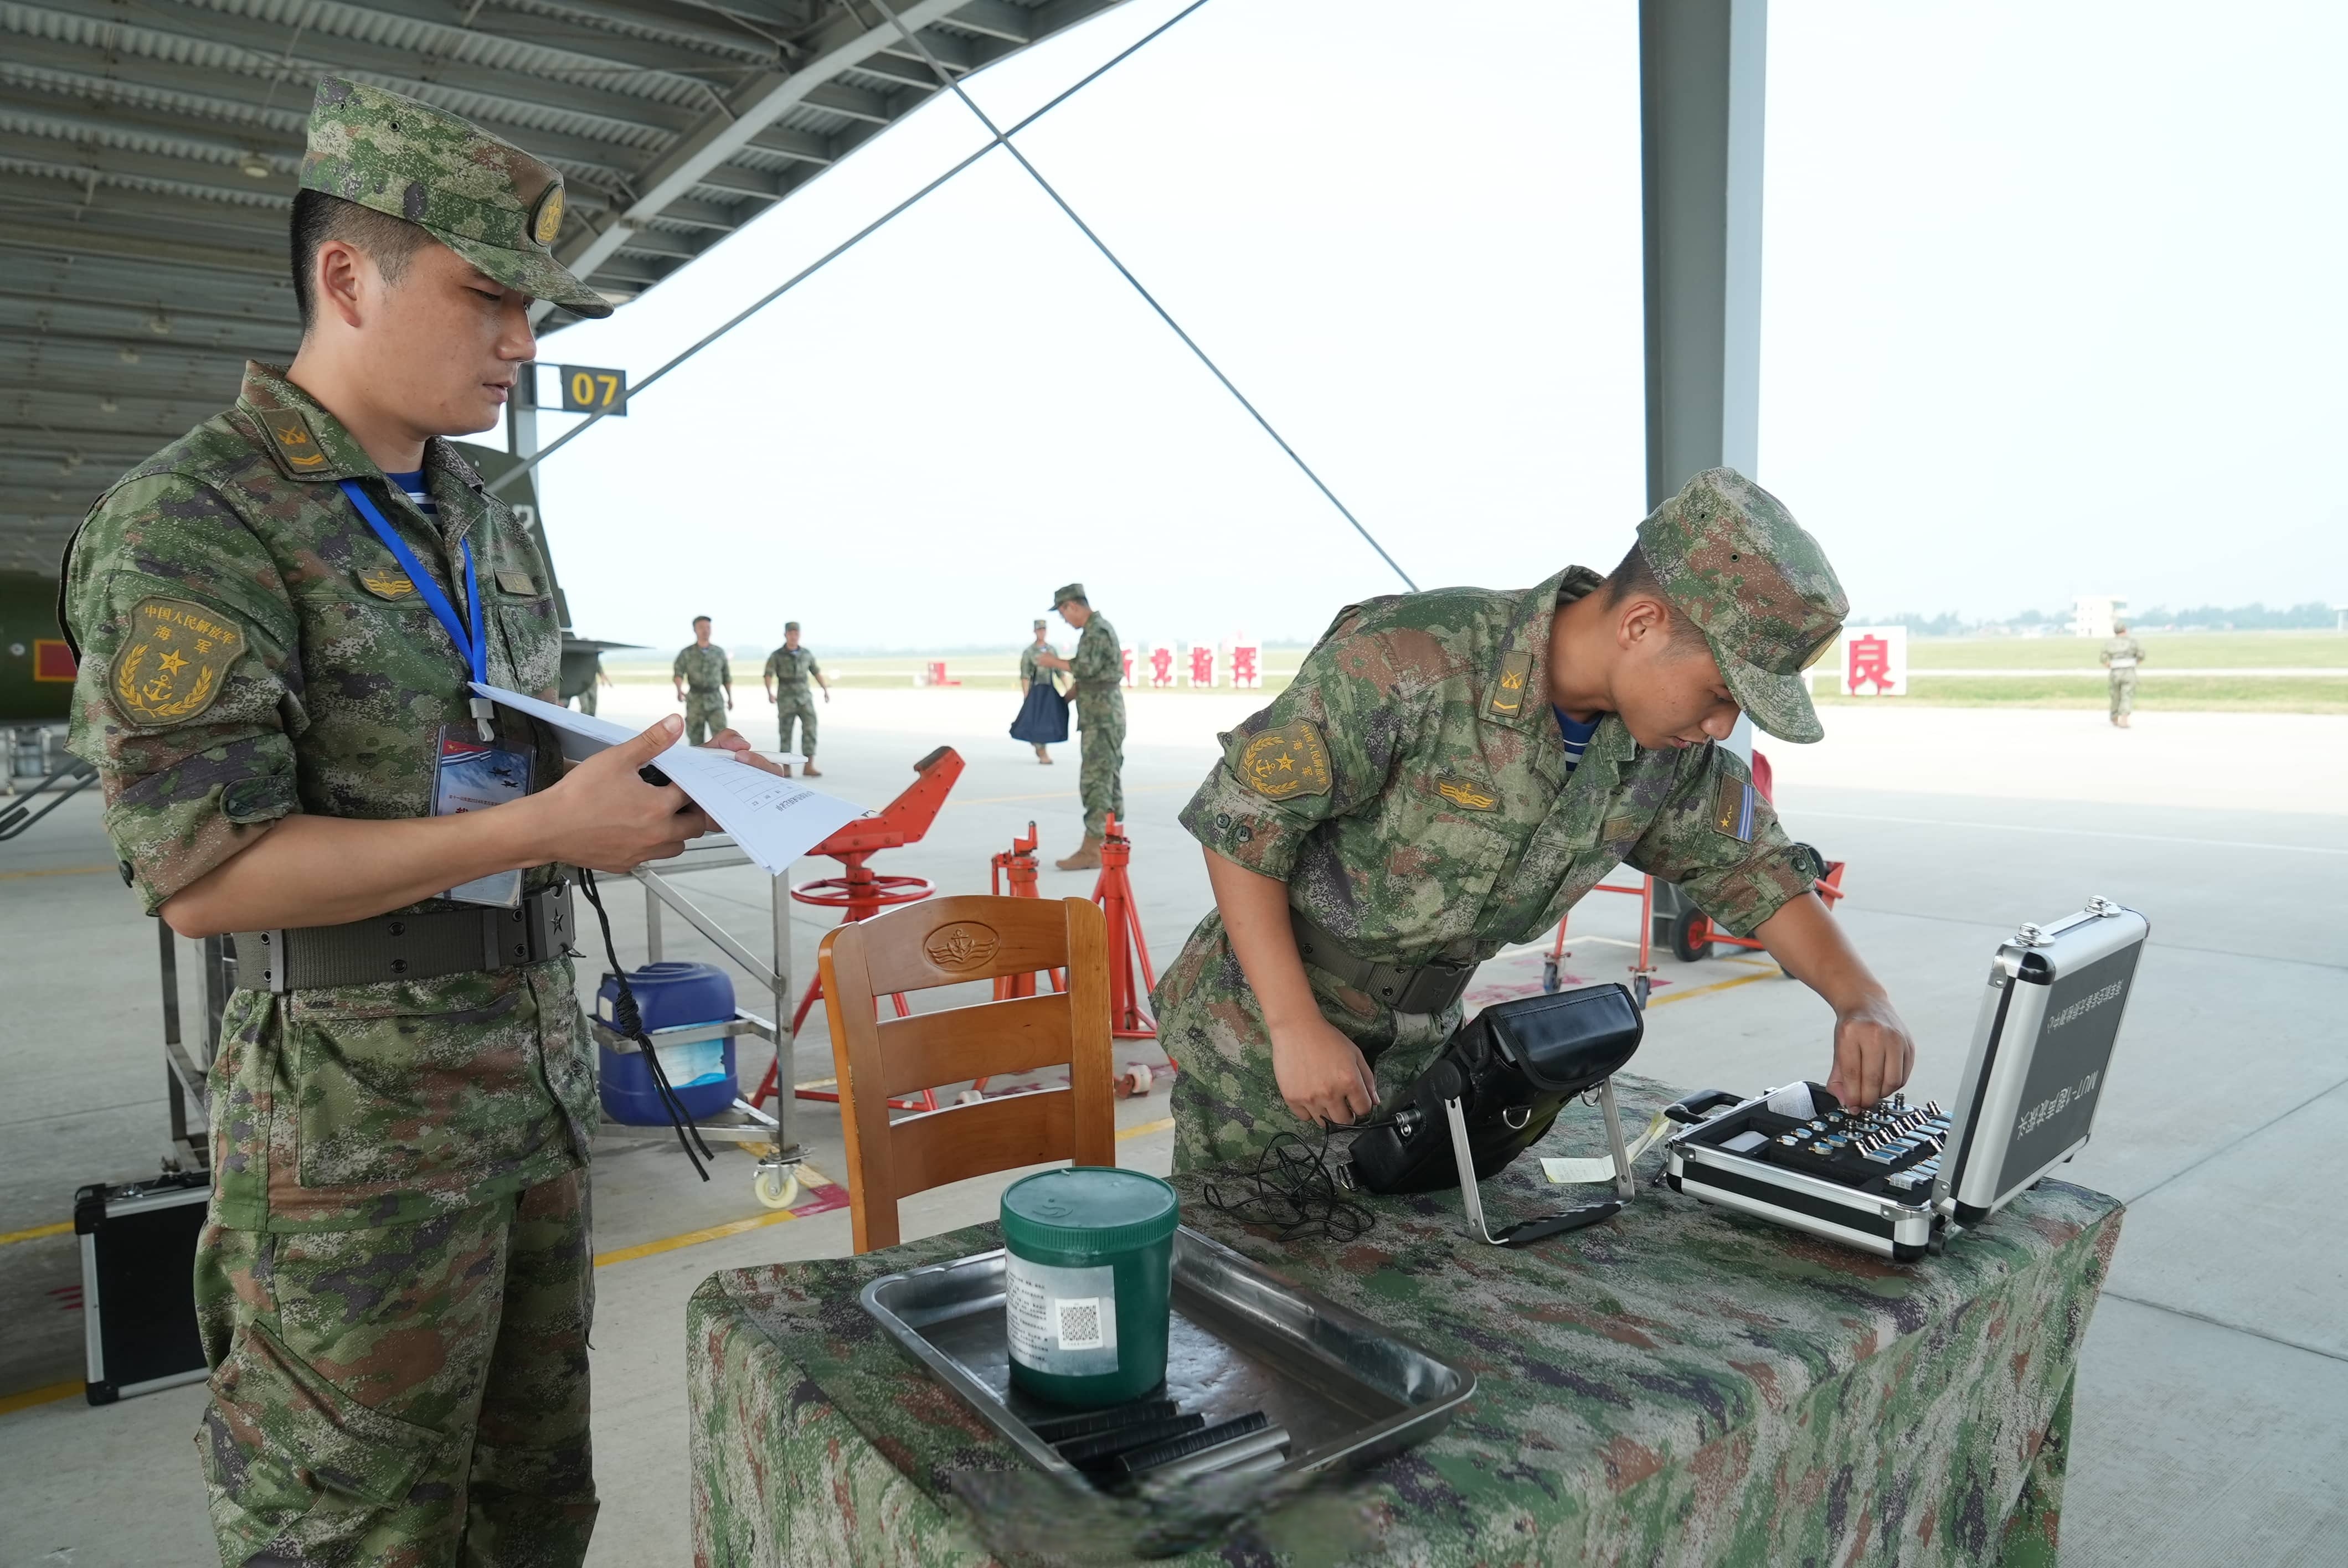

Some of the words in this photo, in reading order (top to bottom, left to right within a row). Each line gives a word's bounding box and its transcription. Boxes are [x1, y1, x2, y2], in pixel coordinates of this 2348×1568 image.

[571, 372, 619, 406] 07
[145, 605, 235, 644] 中国人民解放军
[153, 625, 213, 654] 海军
[1847, 634, 1896, 688] 良
[1300, 725, 1327, 785] 中国人民解放军
